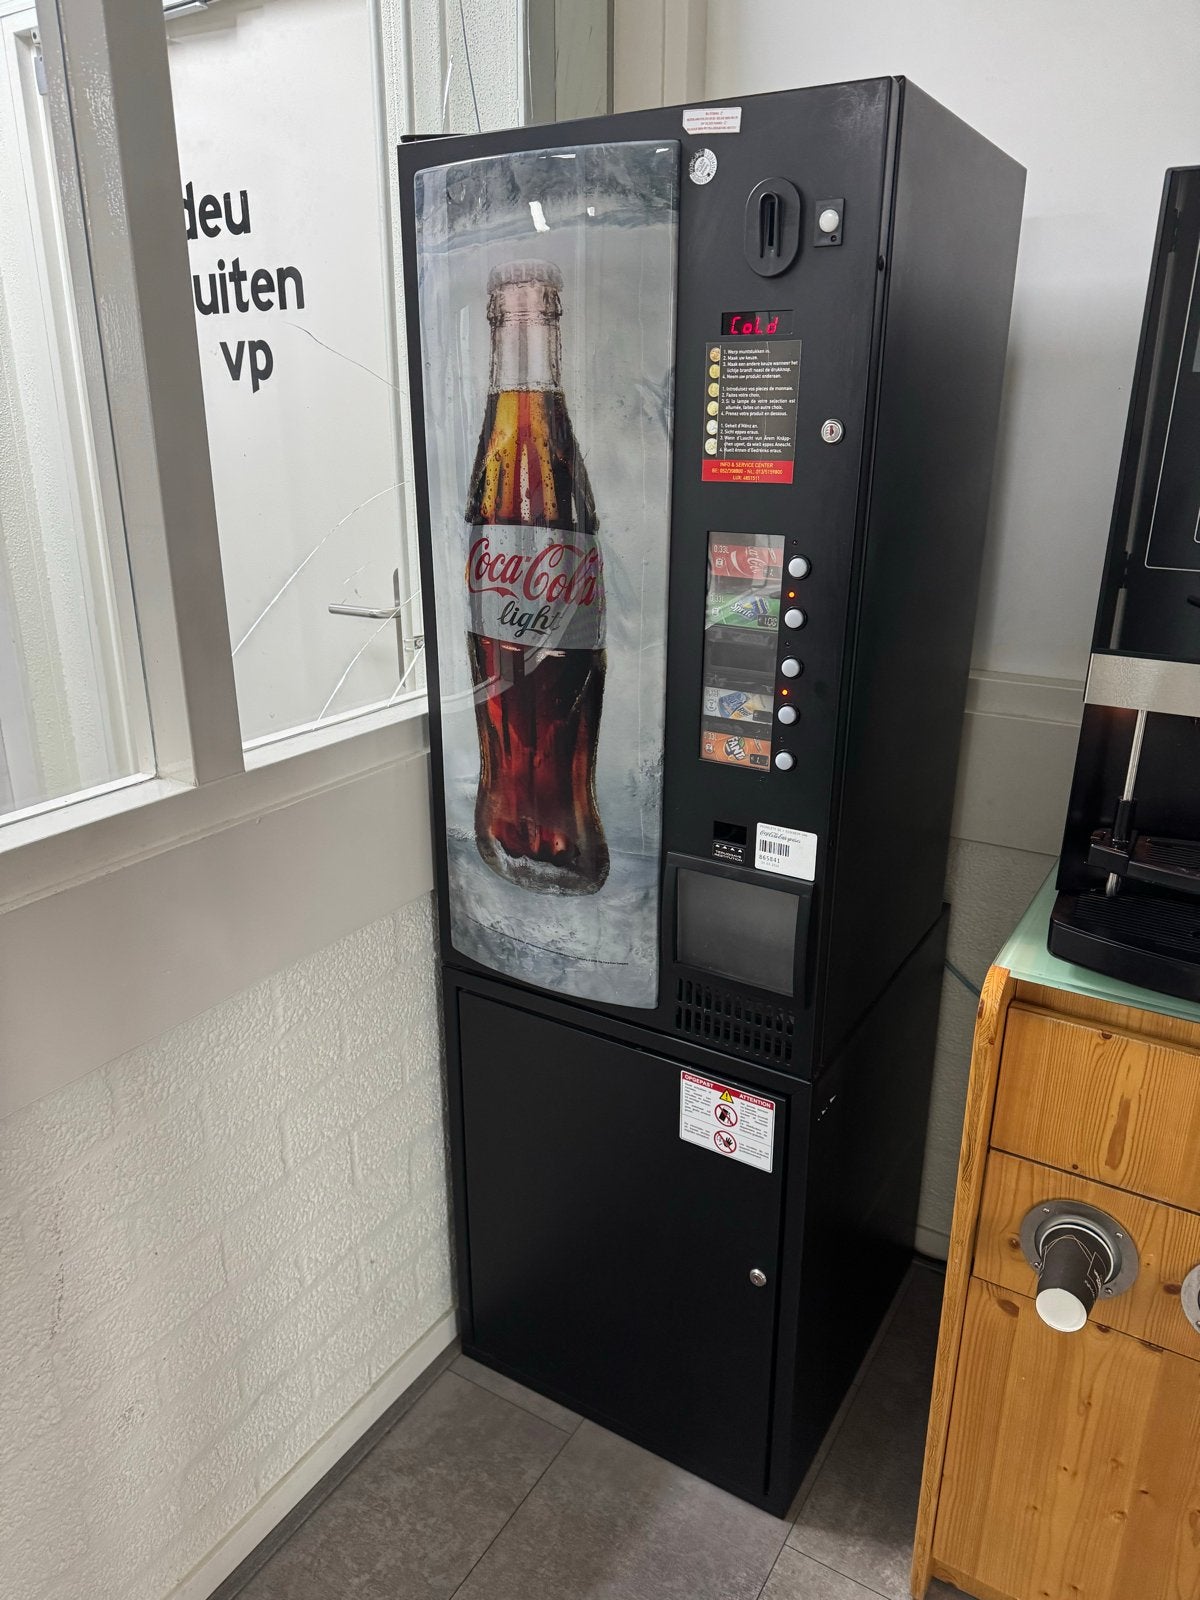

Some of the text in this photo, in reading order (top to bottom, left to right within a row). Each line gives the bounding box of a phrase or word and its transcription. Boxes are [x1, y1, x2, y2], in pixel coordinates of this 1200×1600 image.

[192, 257, 304, 316] uiten
[731, 316, 778, 334] Cold
[220, 340, 274, 394] vp
[468, 538, 598, 606] Coca-Cola
[498, 601, 563, 638] light
[731, 601, 754, 617] Sprite
[684, 1074, 714, 1088] OPGEPAST
[738, 1094, 771, 1108] ATTENTION
